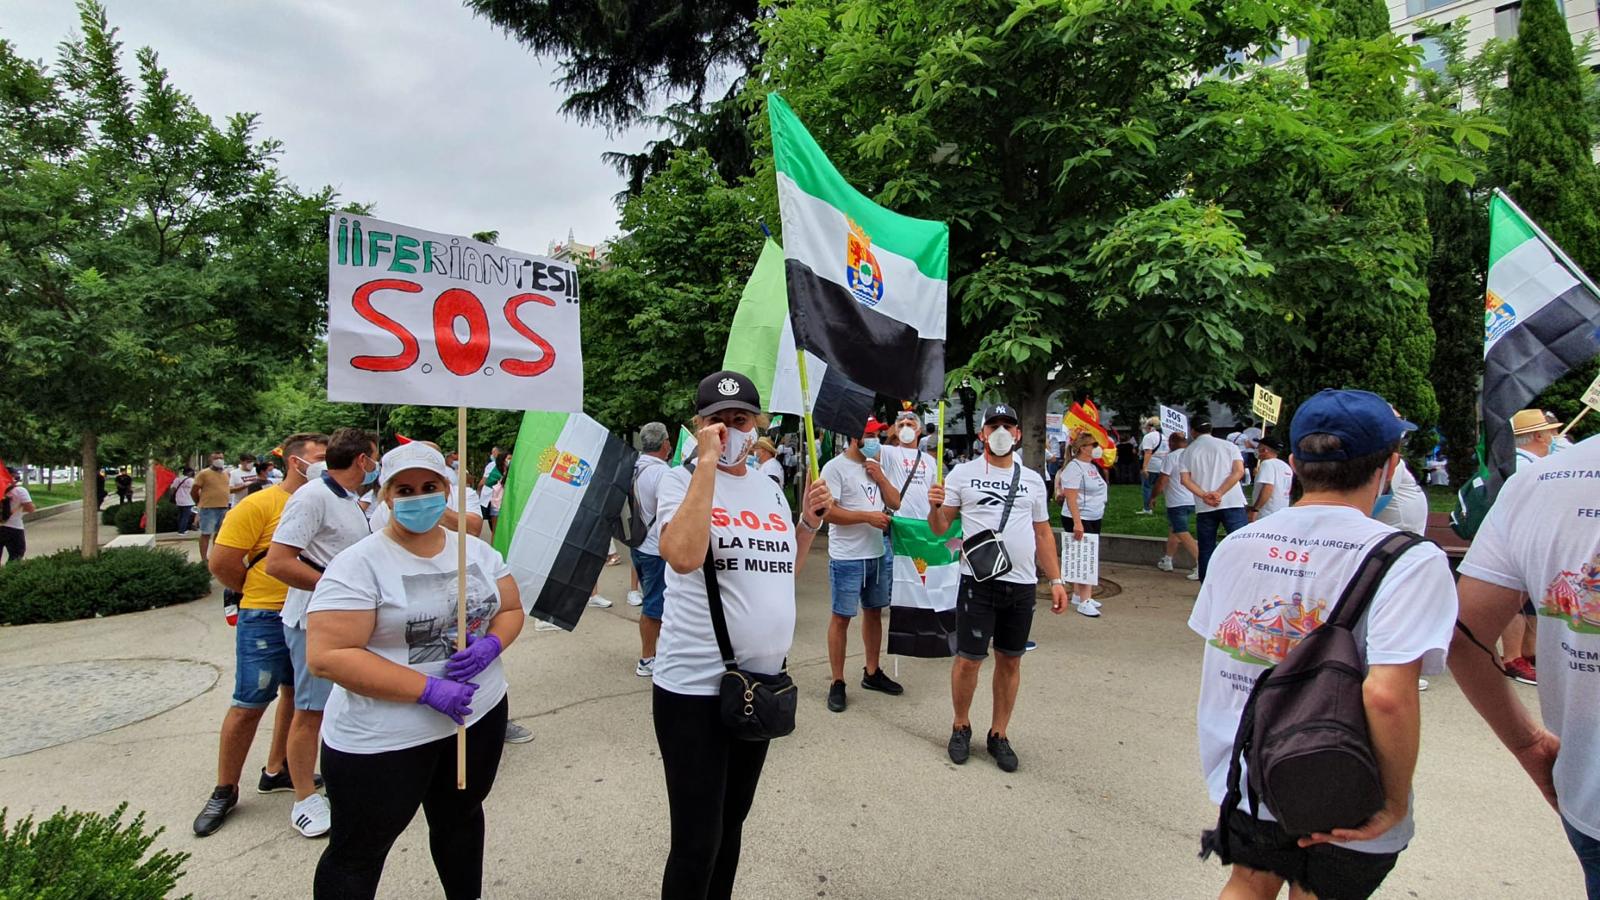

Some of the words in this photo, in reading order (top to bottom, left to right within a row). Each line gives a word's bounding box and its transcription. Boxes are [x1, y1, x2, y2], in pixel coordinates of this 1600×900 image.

[350, 278, 556, 377] S.O.S
[1258, 389, 1274, 406] SOS
[1166, 409, 1181, 423] SOS
[970, 479, 1029, 494] Reebk
[711, 506, 788, 532] S.O.S
[718, 536, 743, 549] LA
[749, 538, 790, 553] FERIA
[715, 558, 738, 571] SE
[744, 558, 793, 574] MUERE
